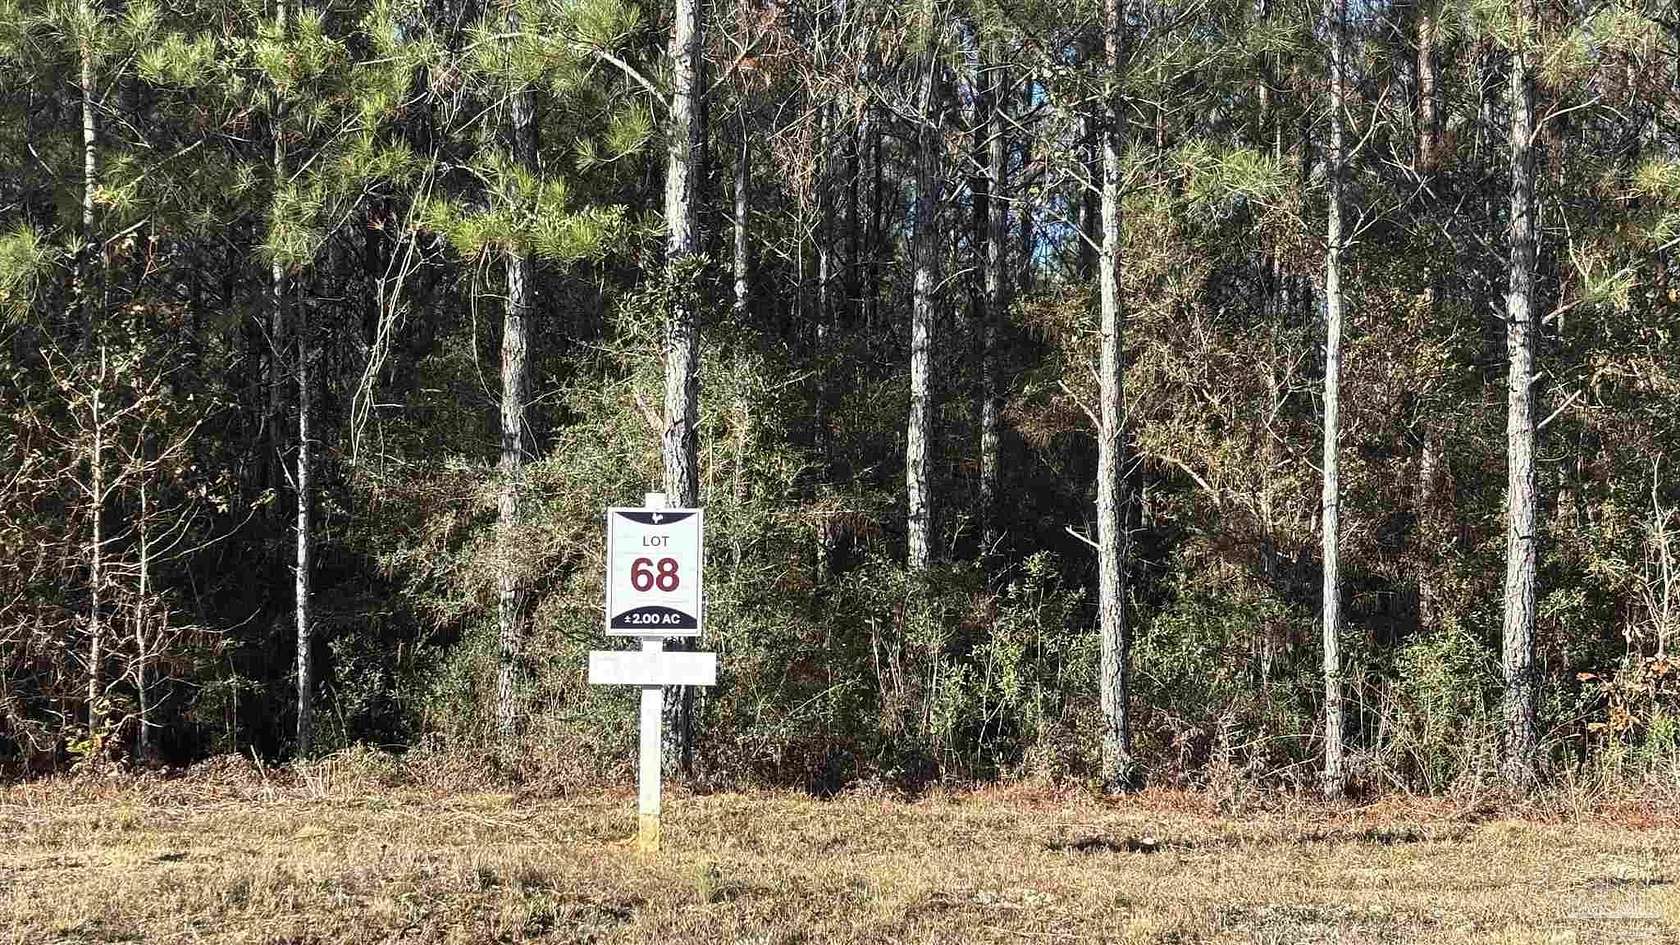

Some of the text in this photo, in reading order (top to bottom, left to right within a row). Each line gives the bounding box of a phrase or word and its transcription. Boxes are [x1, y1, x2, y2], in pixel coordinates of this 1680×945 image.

[643, 535, 670, 547] LOT
[630, 557, 680, 592] 68
[624, 613, 681, 624] ±2.00 AC
